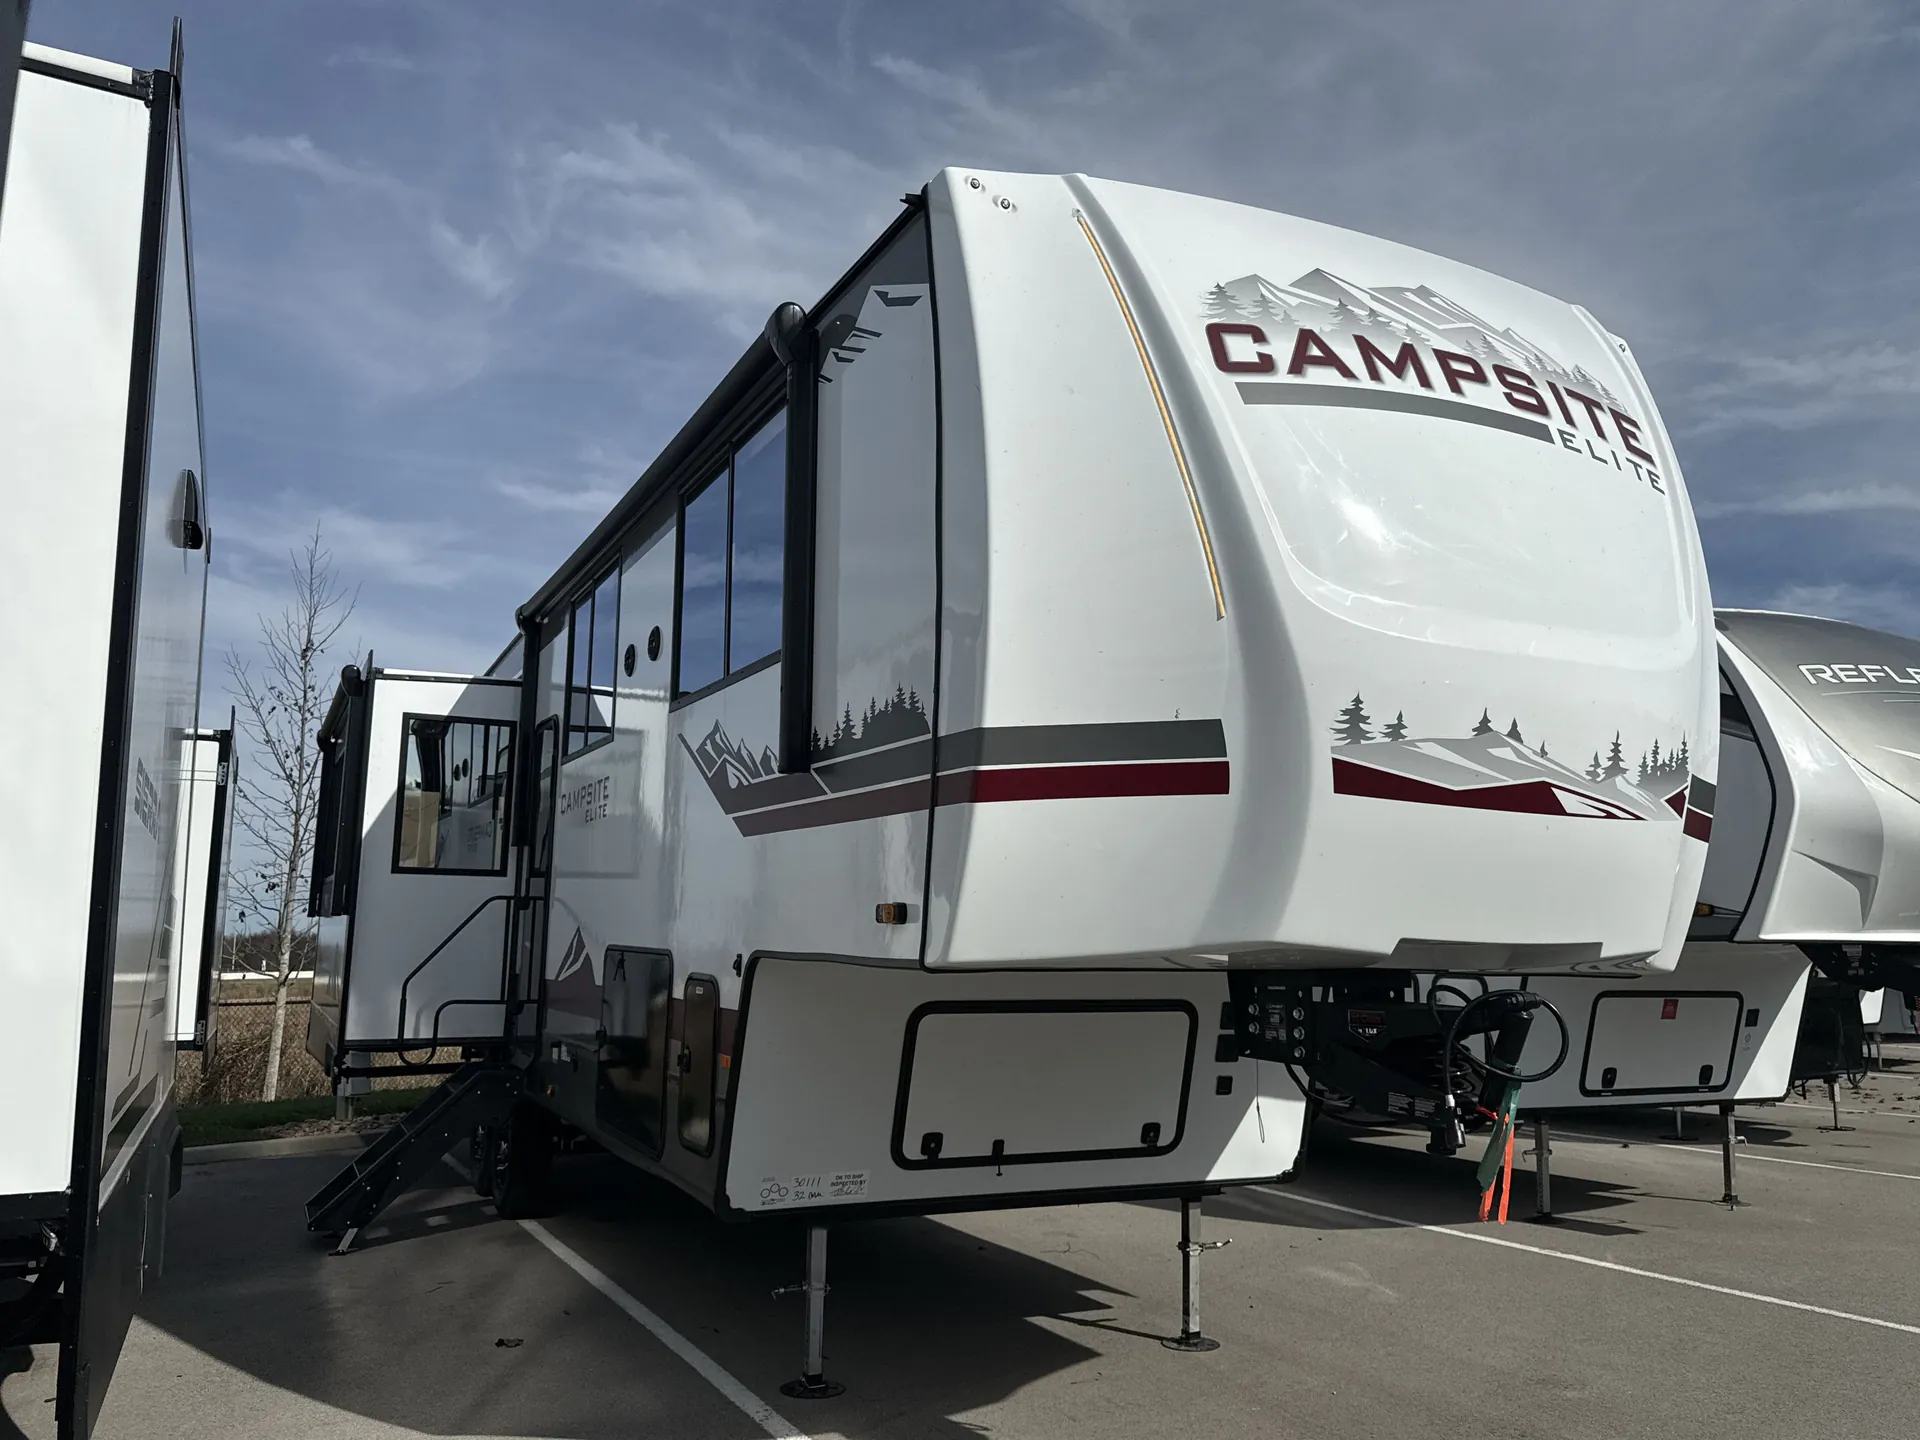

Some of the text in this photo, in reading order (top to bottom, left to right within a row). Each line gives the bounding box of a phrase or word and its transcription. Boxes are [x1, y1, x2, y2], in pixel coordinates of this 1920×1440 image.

[1205, 322, 1656, 467] CAMPSITE
[1557, 428, 1666, 495] ELITE
[561, 775, 610, 814] CAMPSITE
[585, 803, 607, 823] ELITE
